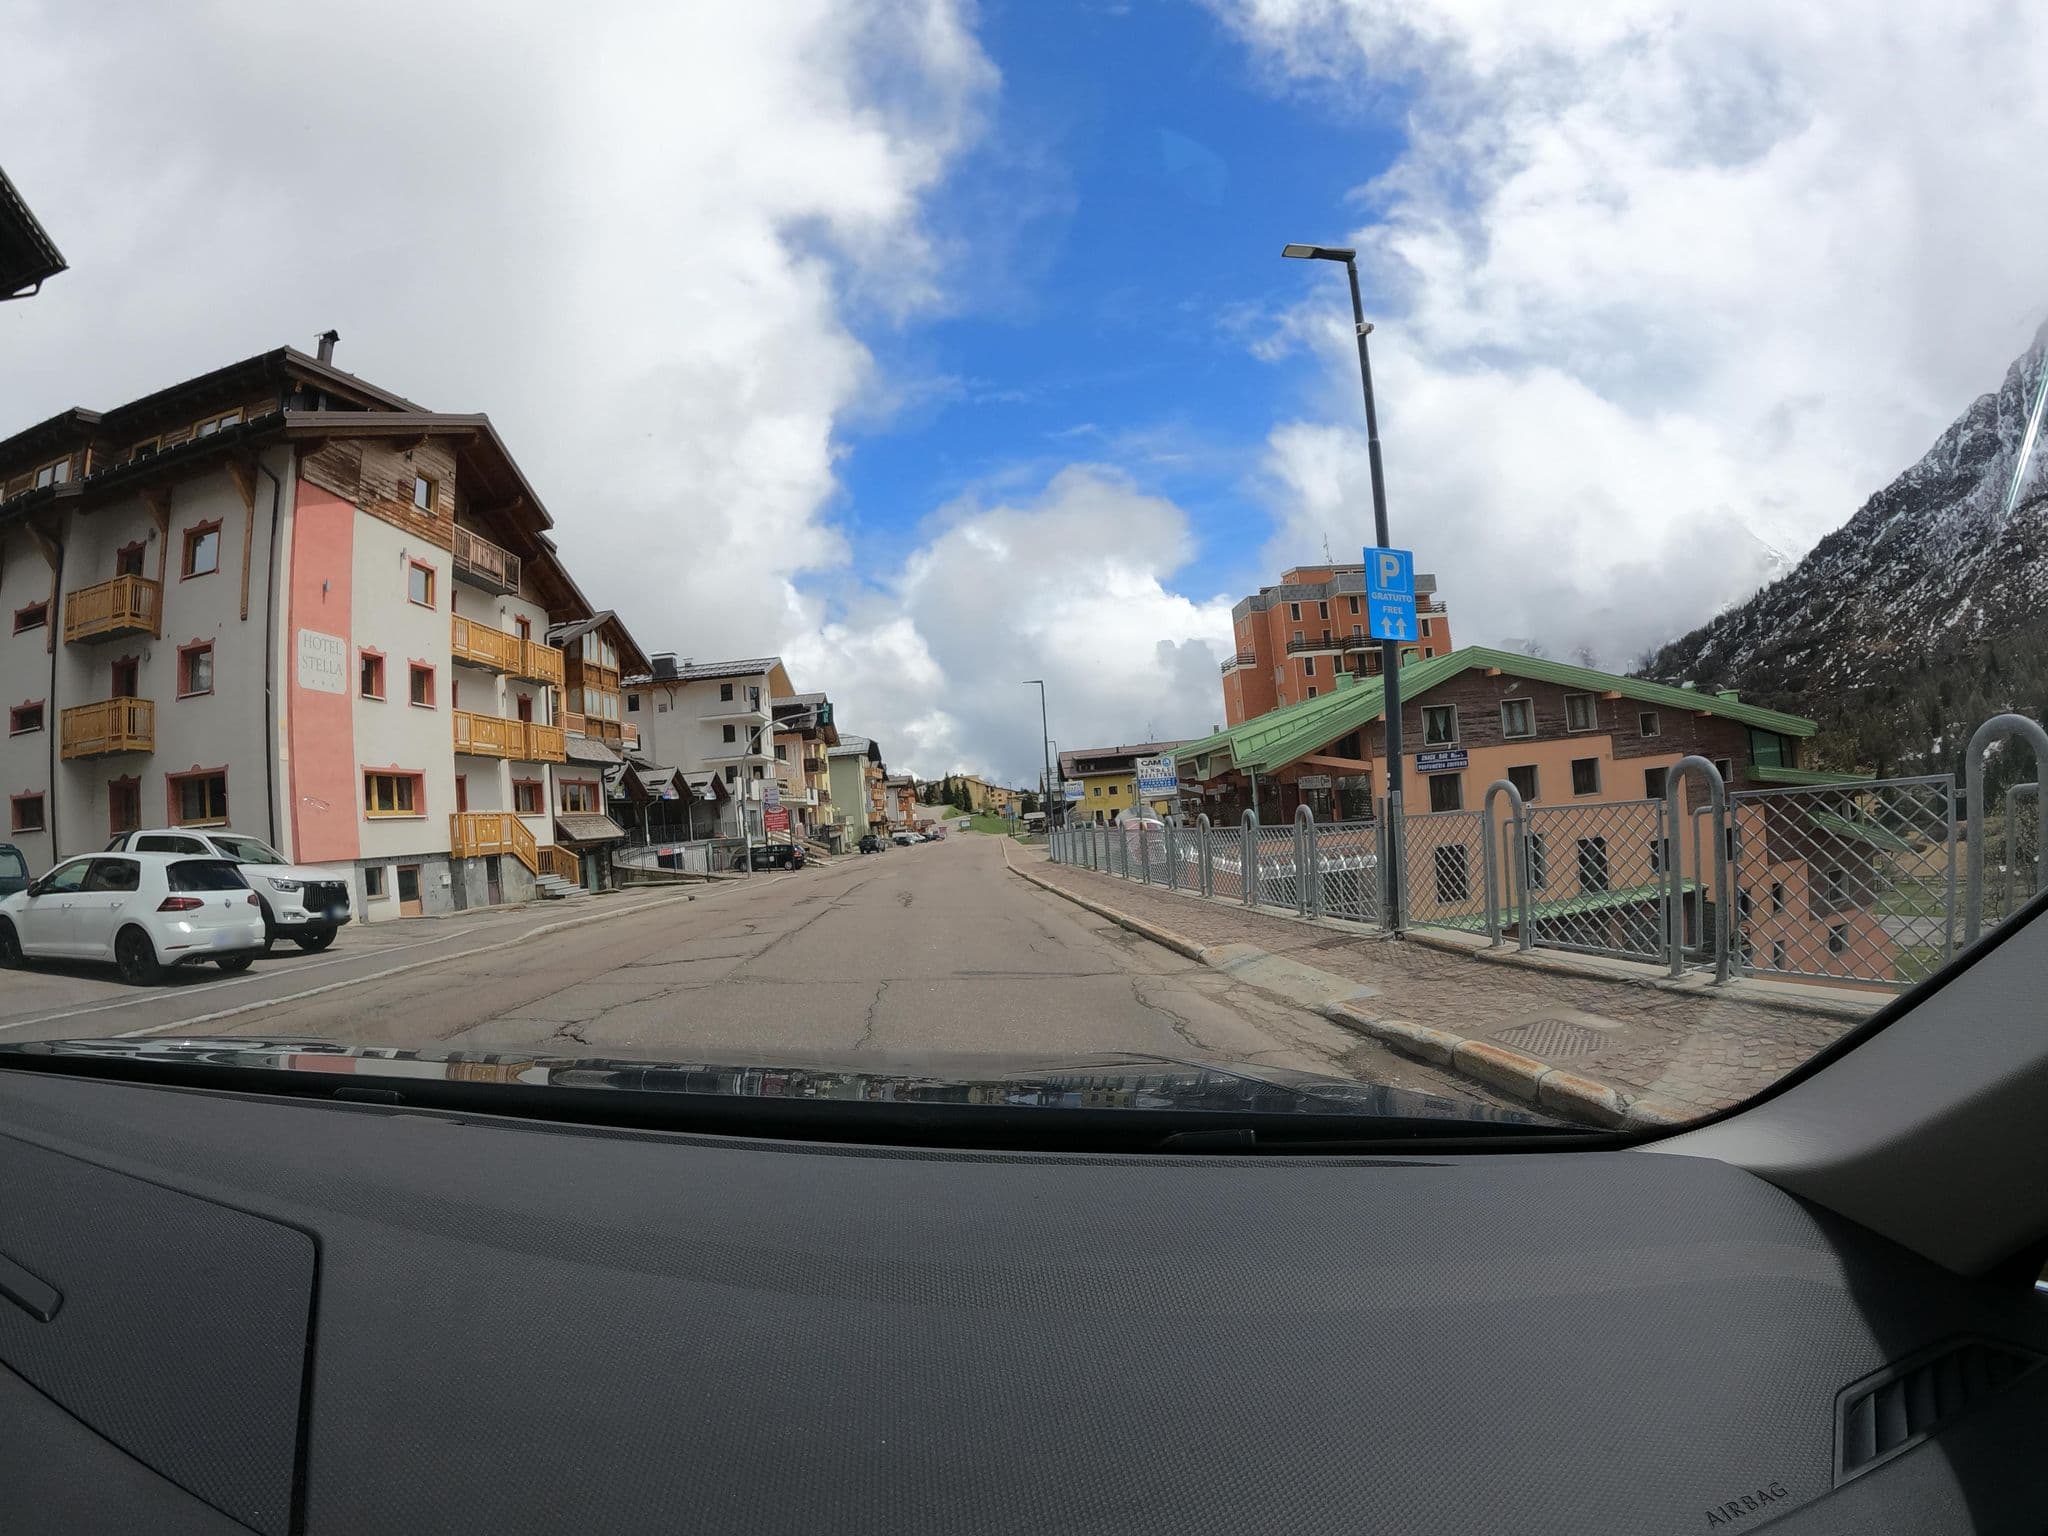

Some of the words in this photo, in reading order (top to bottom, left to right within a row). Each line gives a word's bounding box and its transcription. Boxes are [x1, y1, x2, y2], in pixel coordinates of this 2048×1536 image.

[1380, 553, 1400, 588] P
[1371, 592, 1412, 603] GRATUITO
[1382, 605, 1404, 615] FREE
[303, 633, 344, 656] HOTEL
[302, 655, 343, 677] STELLA
[1705, 1481, 1788, 1529] AIRBAG
